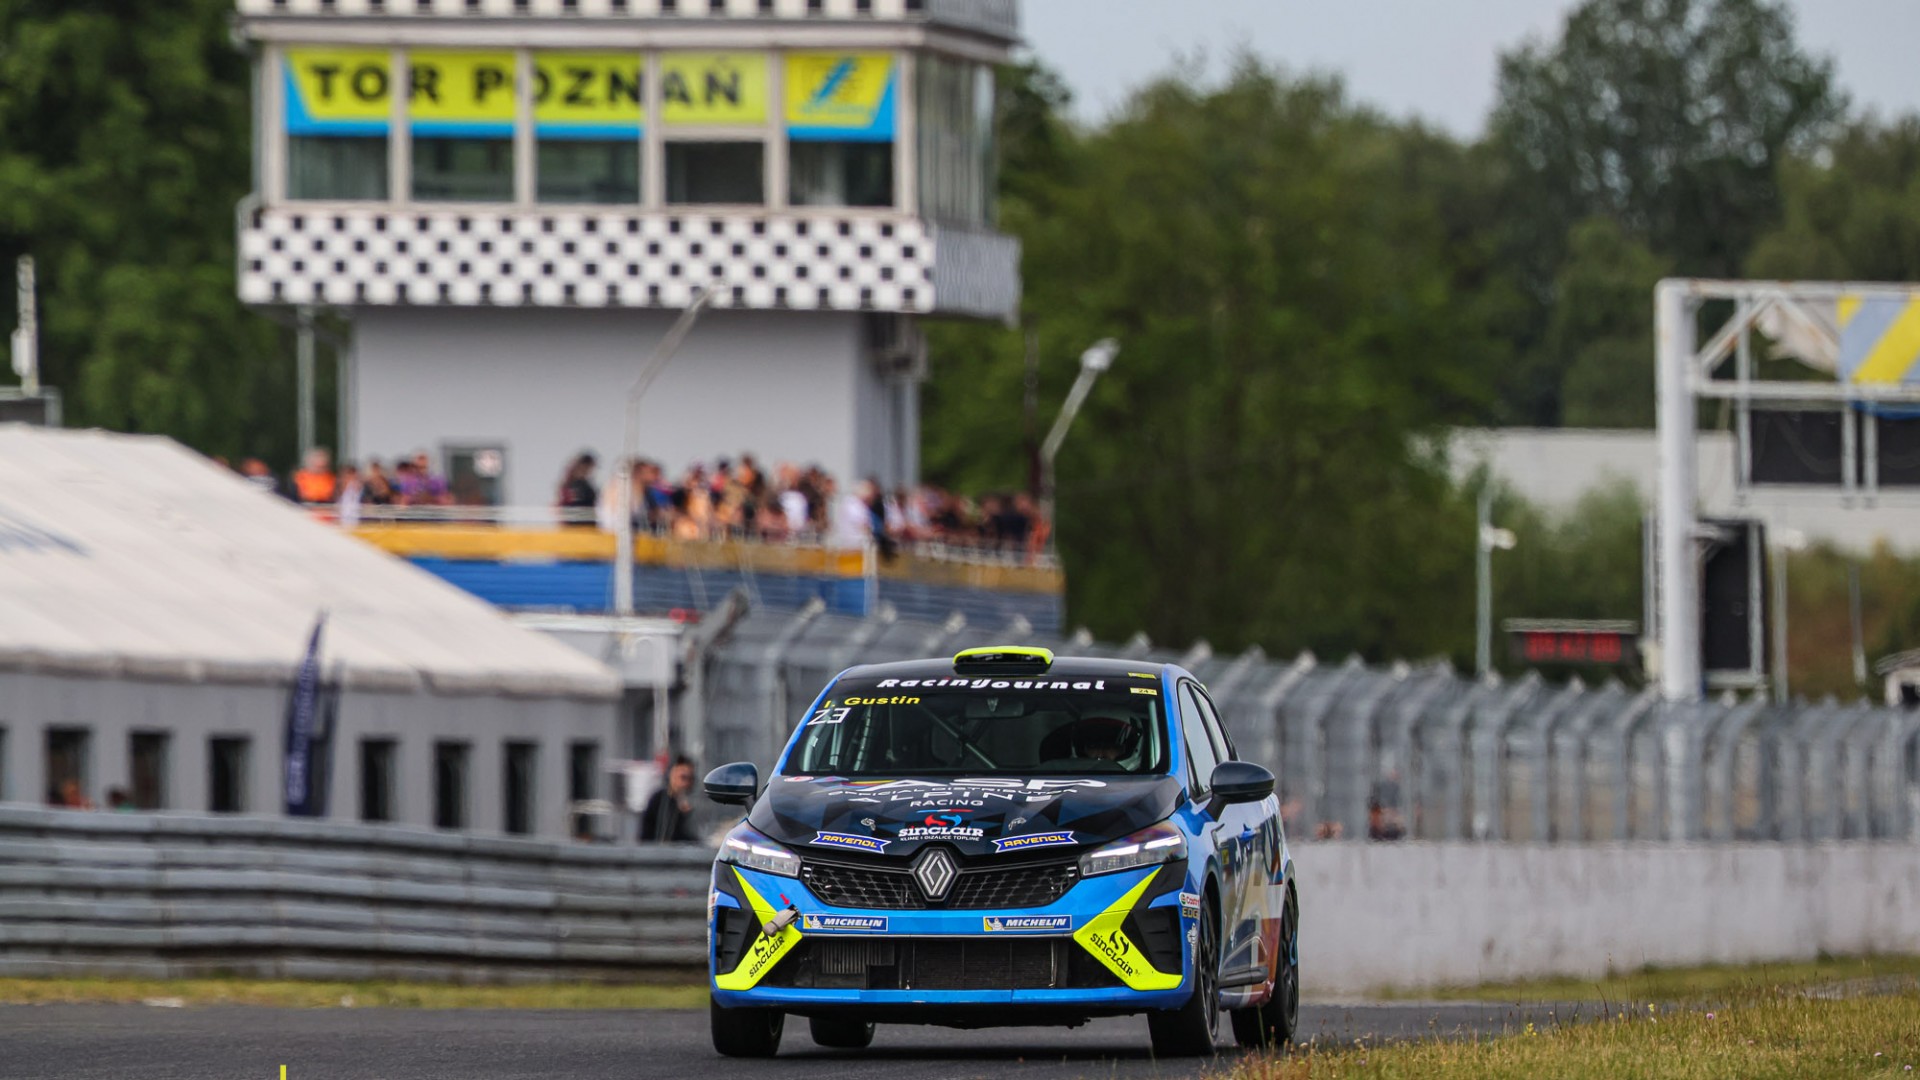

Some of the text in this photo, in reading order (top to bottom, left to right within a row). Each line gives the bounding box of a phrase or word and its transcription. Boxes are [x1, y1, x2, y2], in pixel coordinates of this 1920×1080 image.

[312, 64, 439, 104] TOR
[844, 696, 920, 706] Gustin
[807, 707, 852, 726] 23
[910, 799, 984, 807] RACING
[822, 835, 878, 848] RAVENOL
[1004, 835, 1066, 847] RAVENOL
[824, 918, 883, 927] MICHELIN
[1006, 918, 1066, 927] MICHELIN
